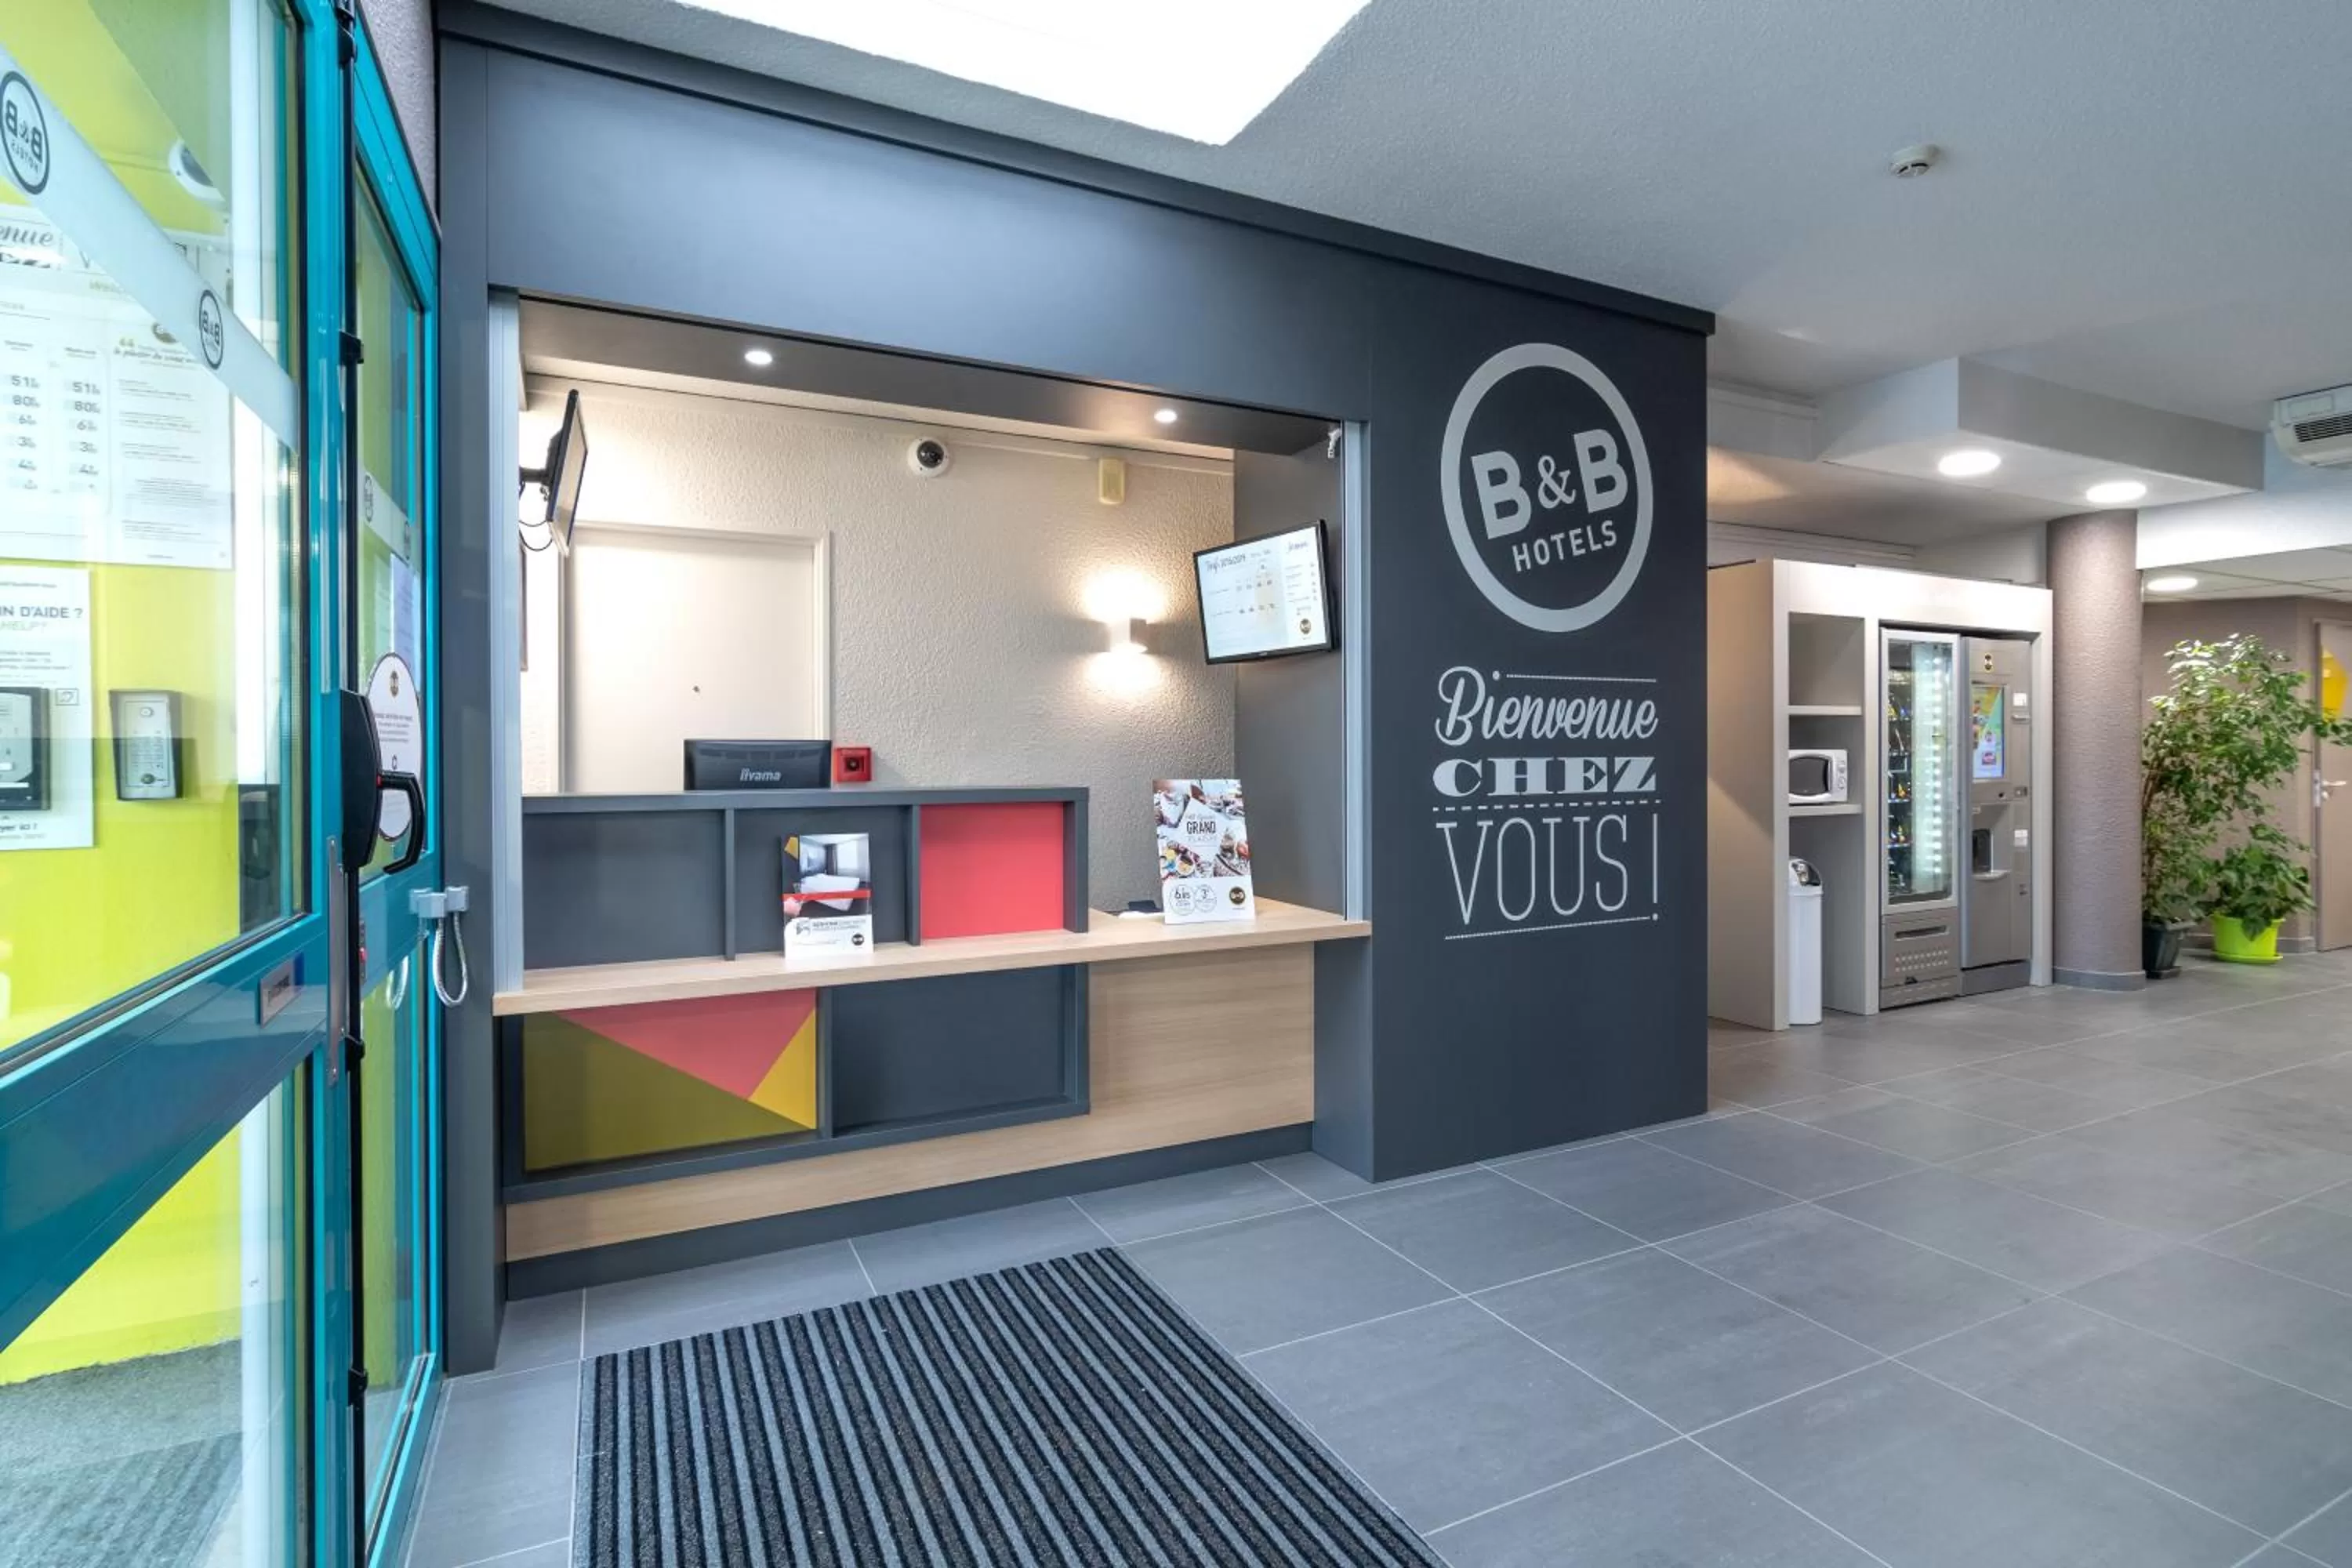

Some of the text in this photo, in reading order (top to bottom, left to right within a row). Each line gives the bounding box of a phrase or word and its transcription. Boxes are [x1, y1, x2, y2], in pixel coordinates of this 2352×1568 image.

[1471, 428, 1628, 539] B&B
[1512, 520, 1617, 572] HOTELS
[20, 606, 71, 619] D'AIDE
[1435, 666, 1658, 746] Bienvenue
[740, 768, 782, 782] iiyama
[1432, 757, 1656, 797] CHEZ
[1186, 821, 1216, 835] GRAND
